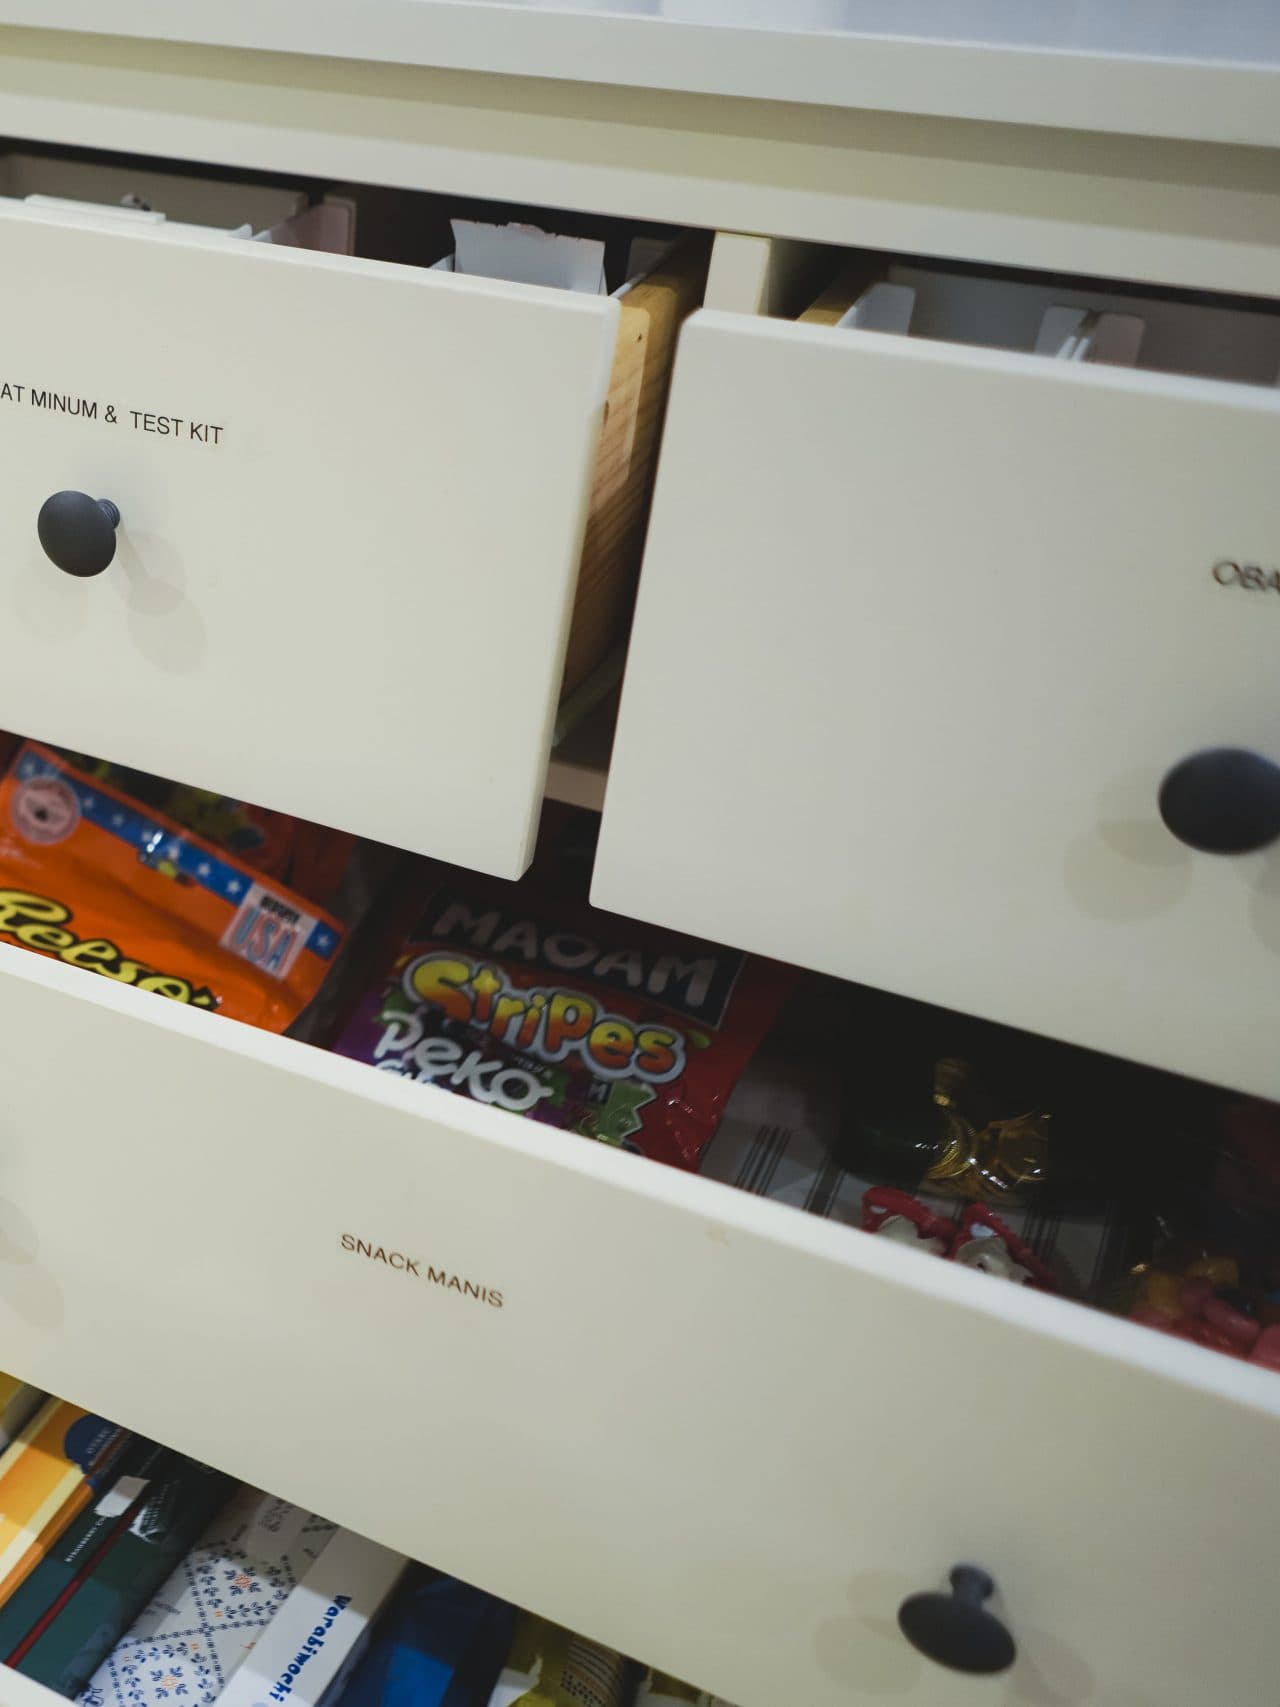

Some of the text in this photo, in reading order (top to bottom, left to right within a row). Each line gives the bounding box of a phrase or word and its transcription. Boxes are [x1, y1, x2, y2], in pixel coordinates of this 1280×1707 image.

[31, 388, 97, 419] MINUM
[104, 404, 118, 424] &
[129, 410, 184, 437] TEST
[190, 422, 224, 444] KIT
[432, 903, 718, 1007] MAOAM
[403, 952, 686, 1082] Stripes
[340, 1233, 504, 1308] SNACK MANIS
[269, 1594, 352, 1702] Warabimochi
